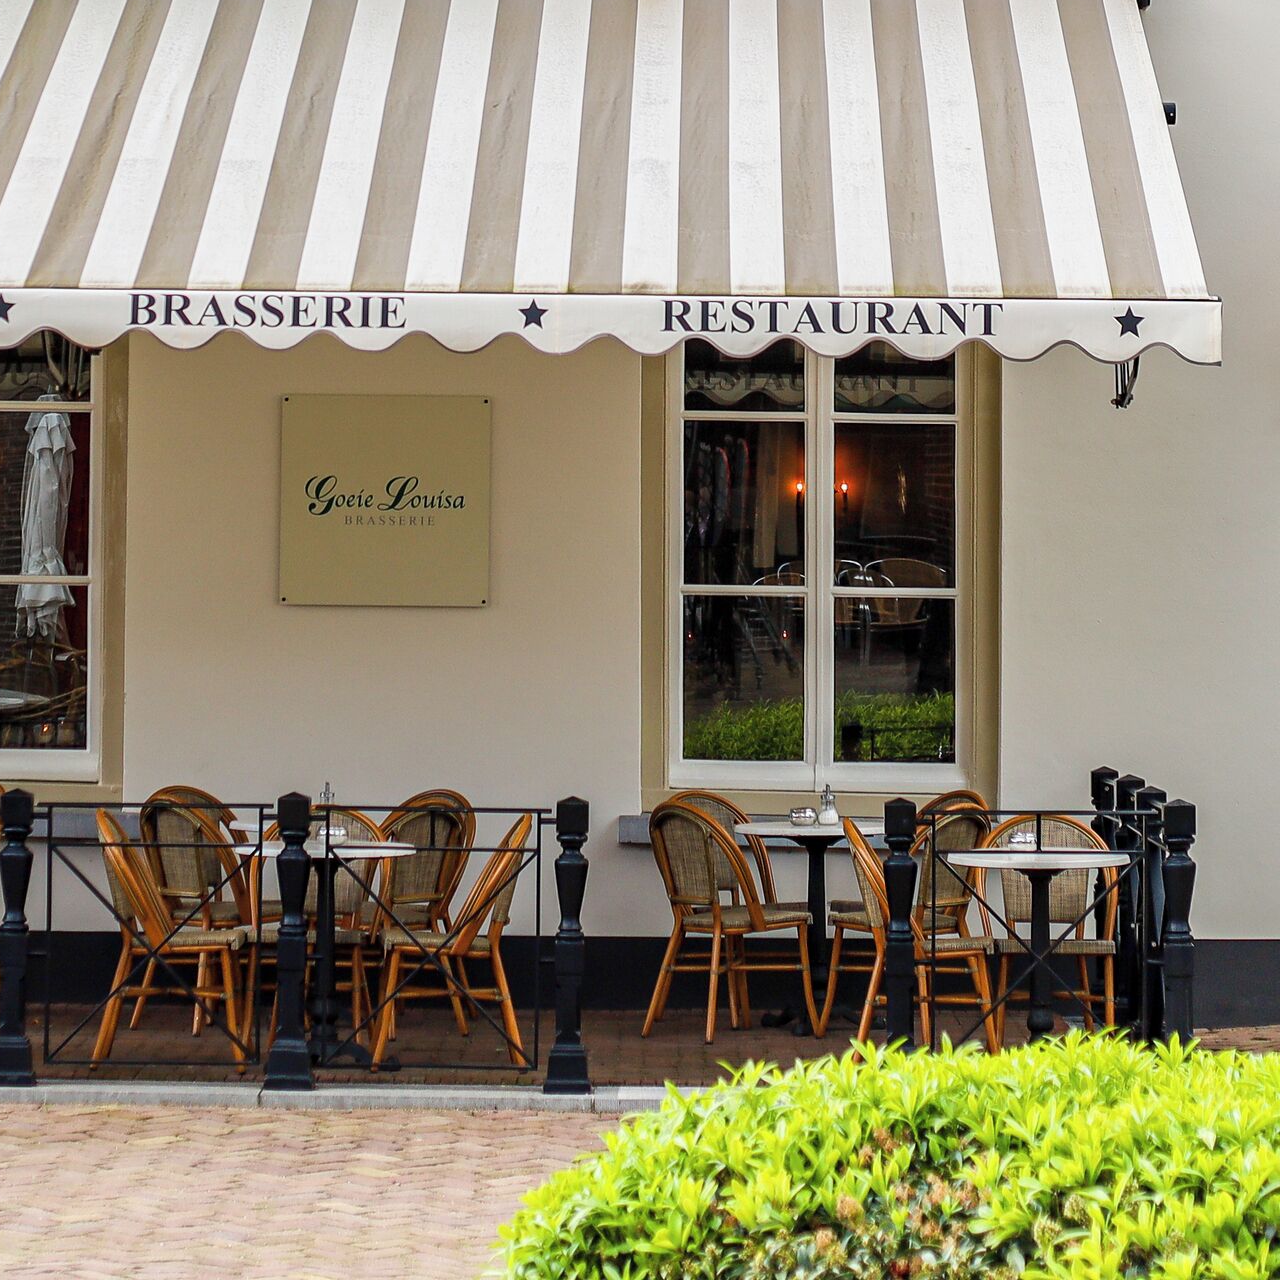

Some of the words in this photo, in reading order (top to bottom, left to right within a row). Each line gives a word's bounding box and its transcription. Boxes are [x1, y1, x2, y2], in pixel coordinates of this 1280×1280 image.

[129, 293, 407, 328] BRASSERIE
[660, 300, 1003, 336] RESTAURANT
[305, 475, 373, 516] Goeie
[377, 476, 465, 511] Louisa
[344, 516, 435, 526] BRASSERIE
